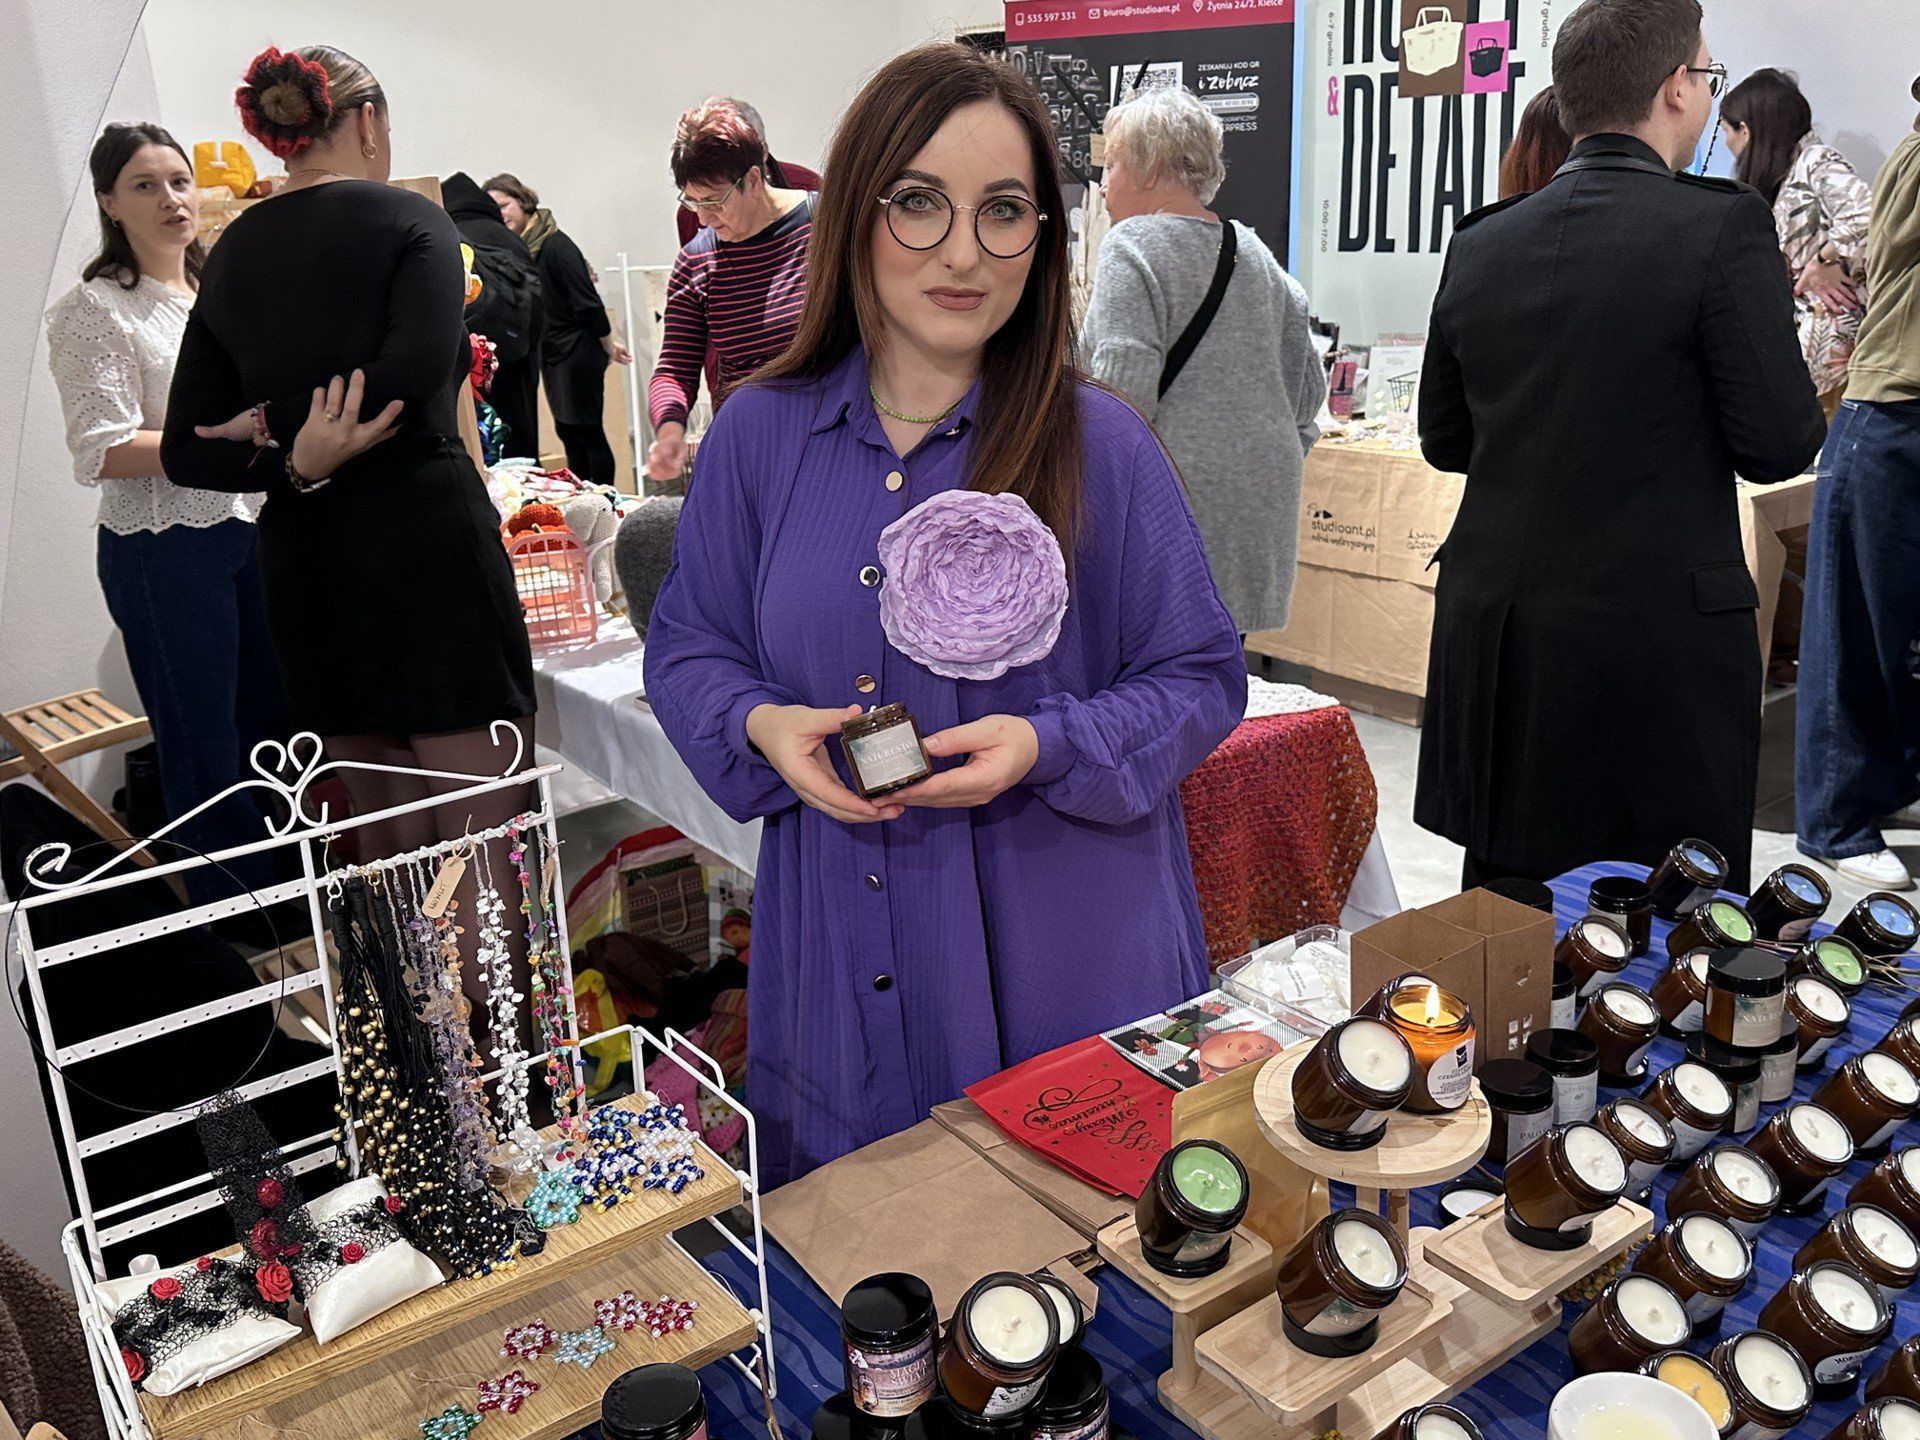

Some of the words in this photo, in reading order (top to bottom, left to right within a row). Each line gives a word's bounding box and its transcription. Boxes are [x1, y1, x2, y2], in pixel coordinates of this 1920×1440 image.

[1027, 14, 1043, 23] 535
[1044, 13, 1060, 22] 597
[1061, 11, 1077, 21] 331
[1103, 5, 1181, 17] biuro@studioant.pl
[1541, 8, 1550, 48] grudnia
[1326, 31, 1334, 67] grudnia
[1197, 63, 1233, 72] ZESKANUJ
[1234, 61, 1248, 69] KOD
[1311, 521, 1376, 539] studioant.pl
